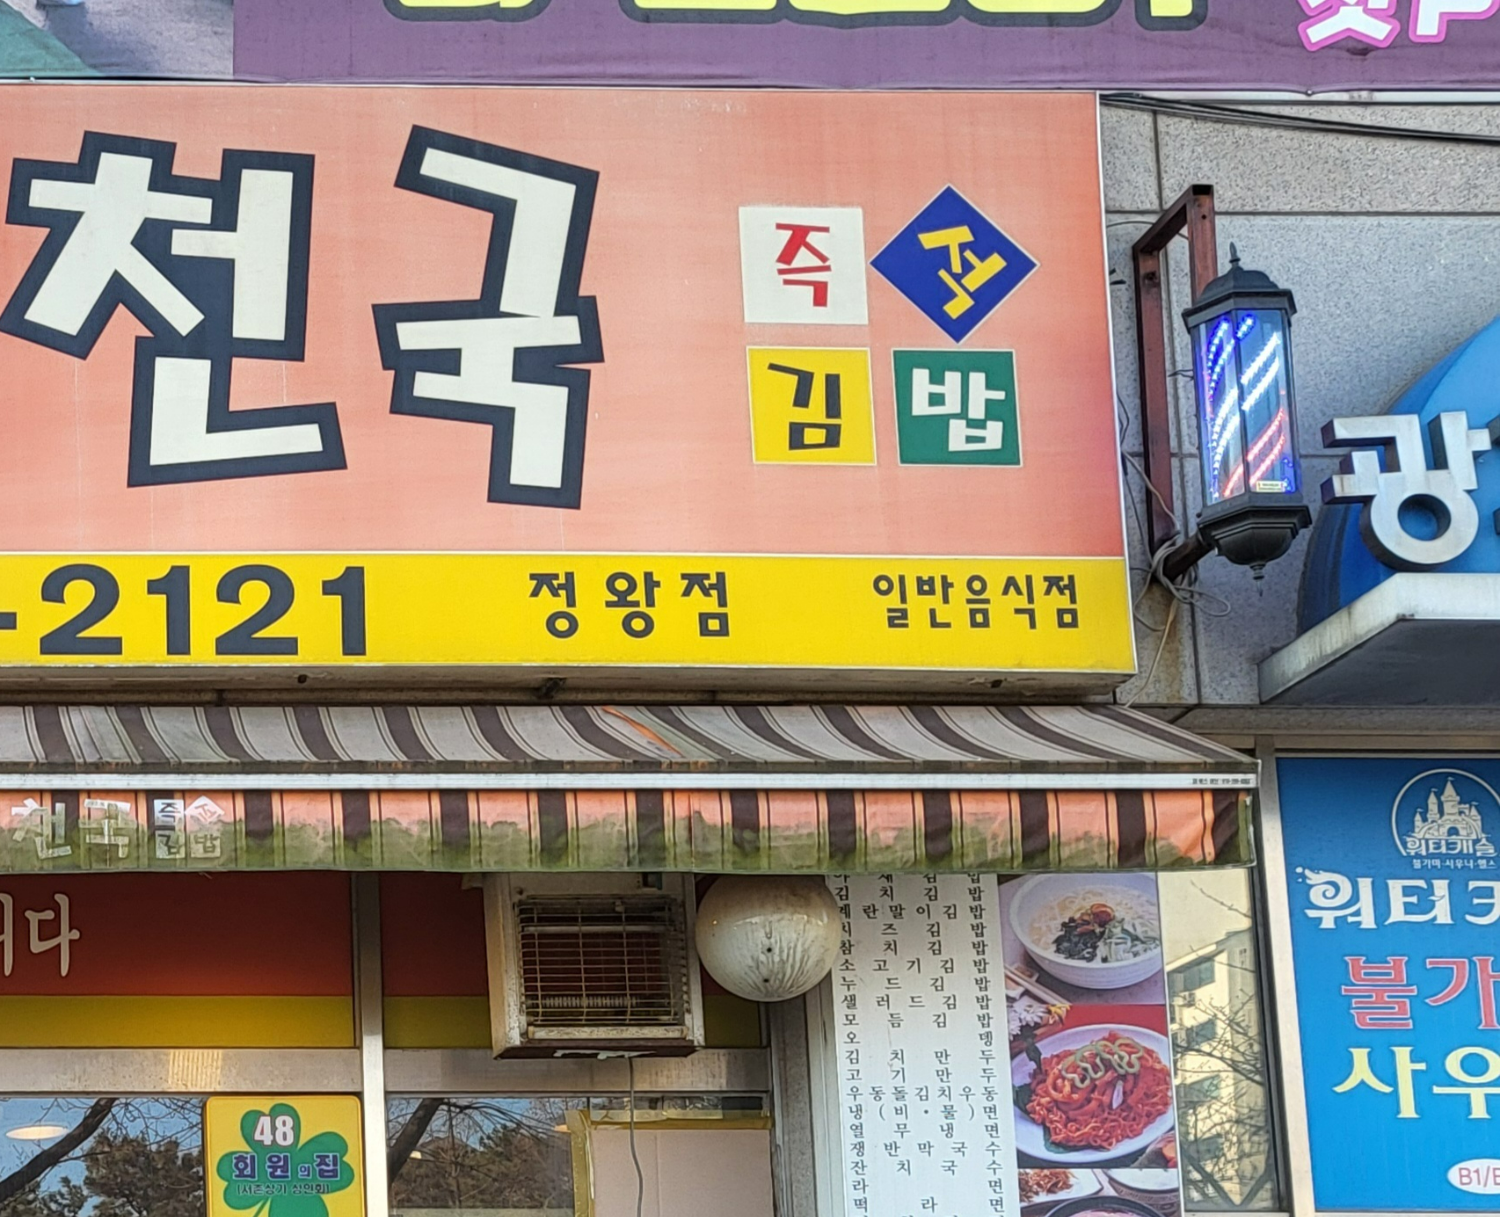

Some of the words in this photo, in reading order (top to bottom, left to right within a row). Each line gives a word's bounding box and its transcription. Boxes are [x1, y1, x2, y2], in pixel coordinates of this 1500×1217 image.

[767, 362, 1006, 452] 김밥
[1321, 411, 1492, 571] 광
[529, 571, 730, 639] 정왕점
[873, 574, 1079, 630] 일반음식점
[254, 1115, 295, 1146] 48
